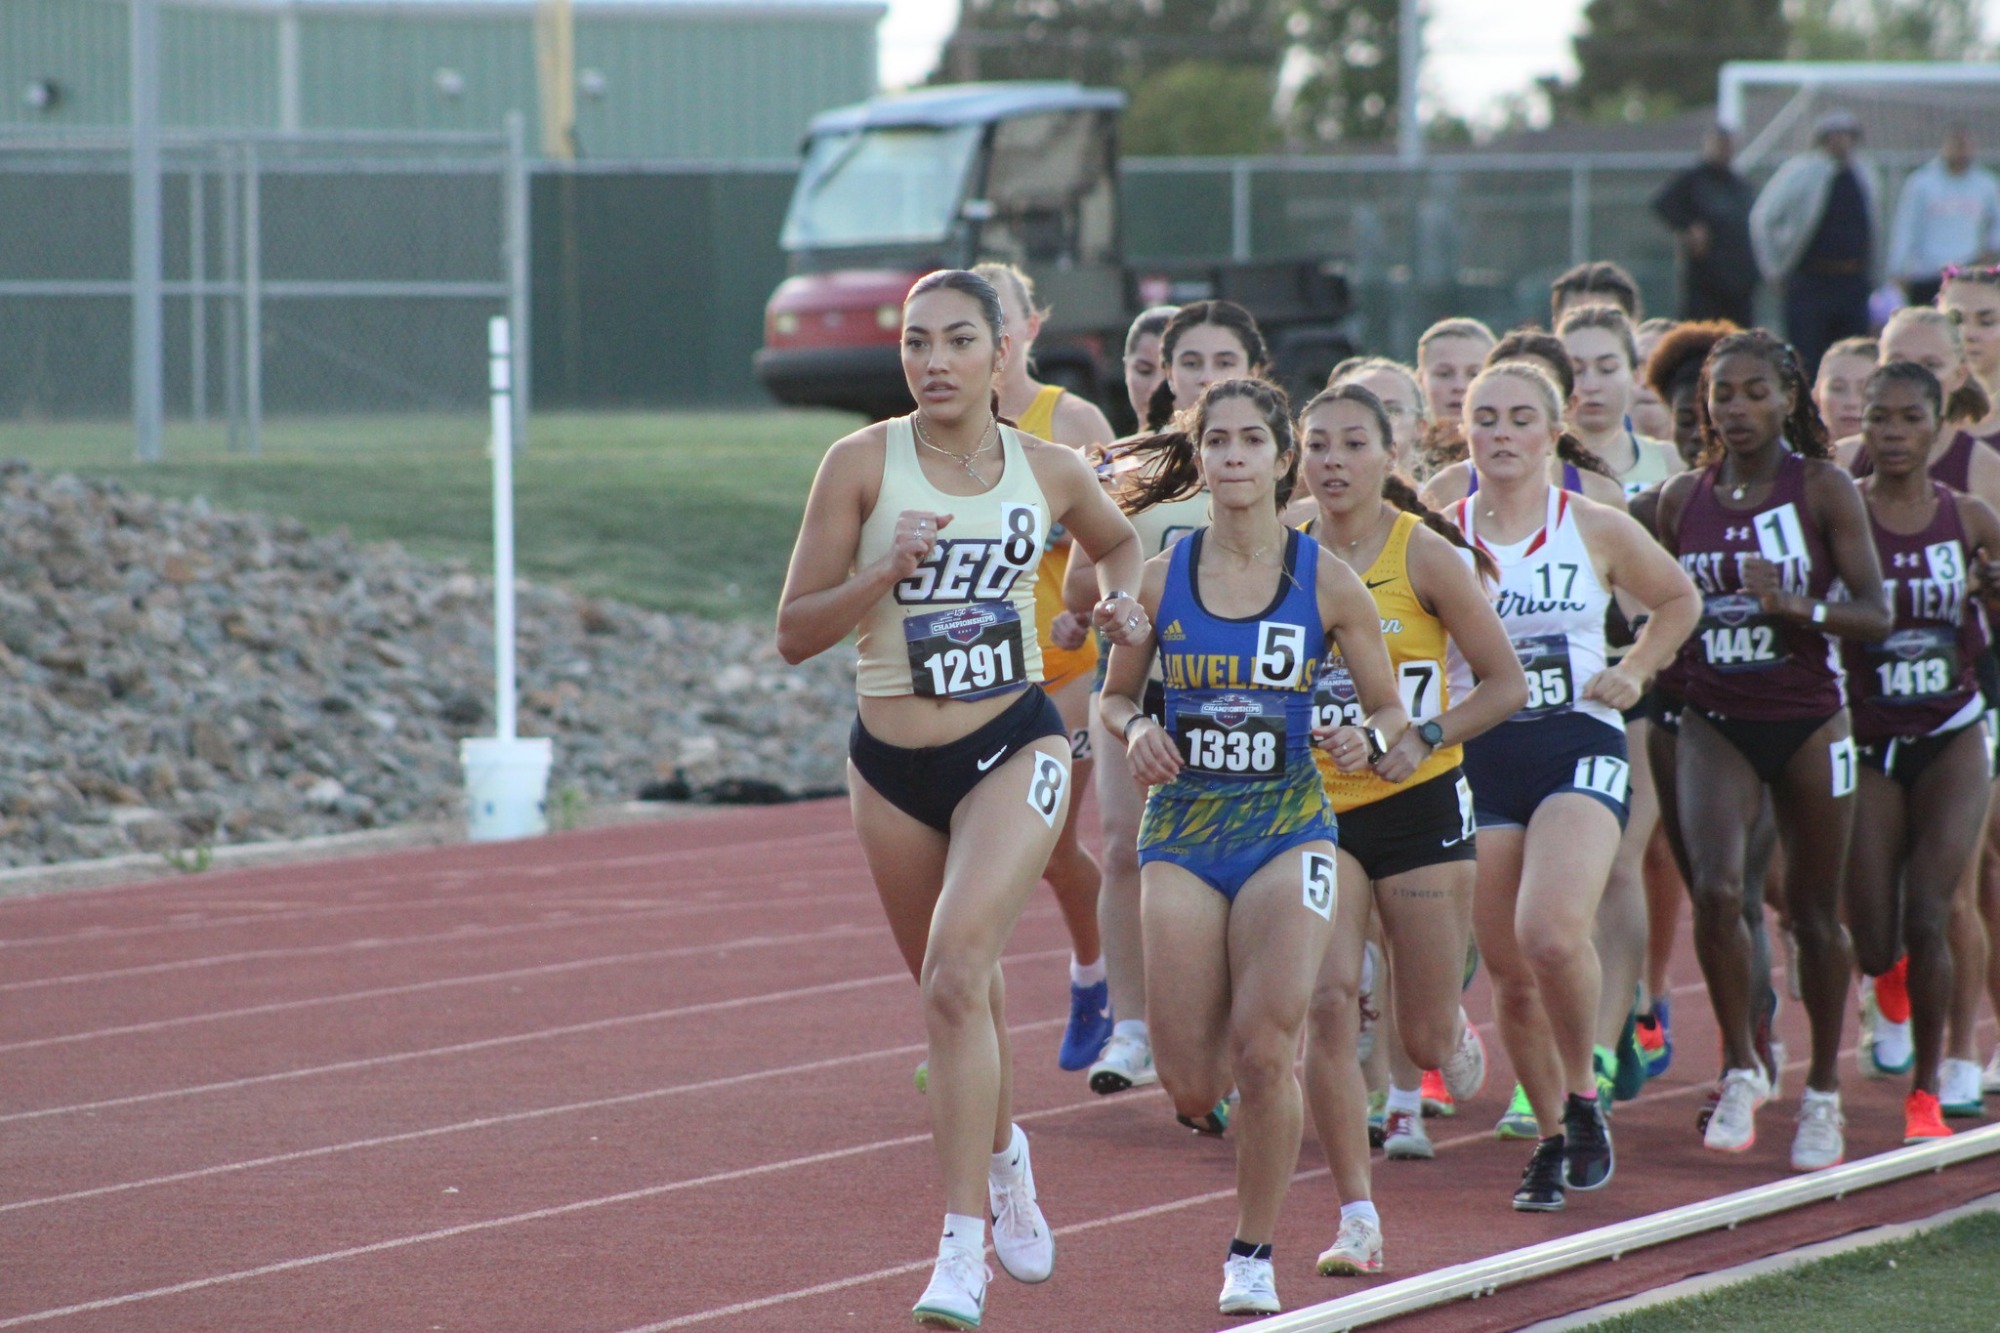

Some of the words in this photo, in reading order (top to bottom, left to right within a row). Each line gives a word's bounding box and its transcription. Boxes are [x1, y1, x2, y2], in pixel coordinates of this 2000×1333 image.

[1004, 507, 1036, 566] 8
[1763, 512, 1790, 557] 1
[1535, 563, 1579, 599] 17
[1935, 545, 1957, 580] 3
[932, 614, 994, 632] CHAMPIONSHIPS
[1262, 626, 1296, 682] 5
[1700, 626, 1775, 665] 1442
[924, 639, 1014, 696] 1291
[1523, 668, 1567, 709] 85
[1876, 657, 1948, 696] 1413
[1404, 666, 1433, 718] 7
[1185, 728, 1276, 772] 1338
[1838, 749, 1851, 790] 1
[1034, 759, 1062, 816] 8
[1582, 755, 1621, 793] 17
[1308, 855, 1333, 910] 5
